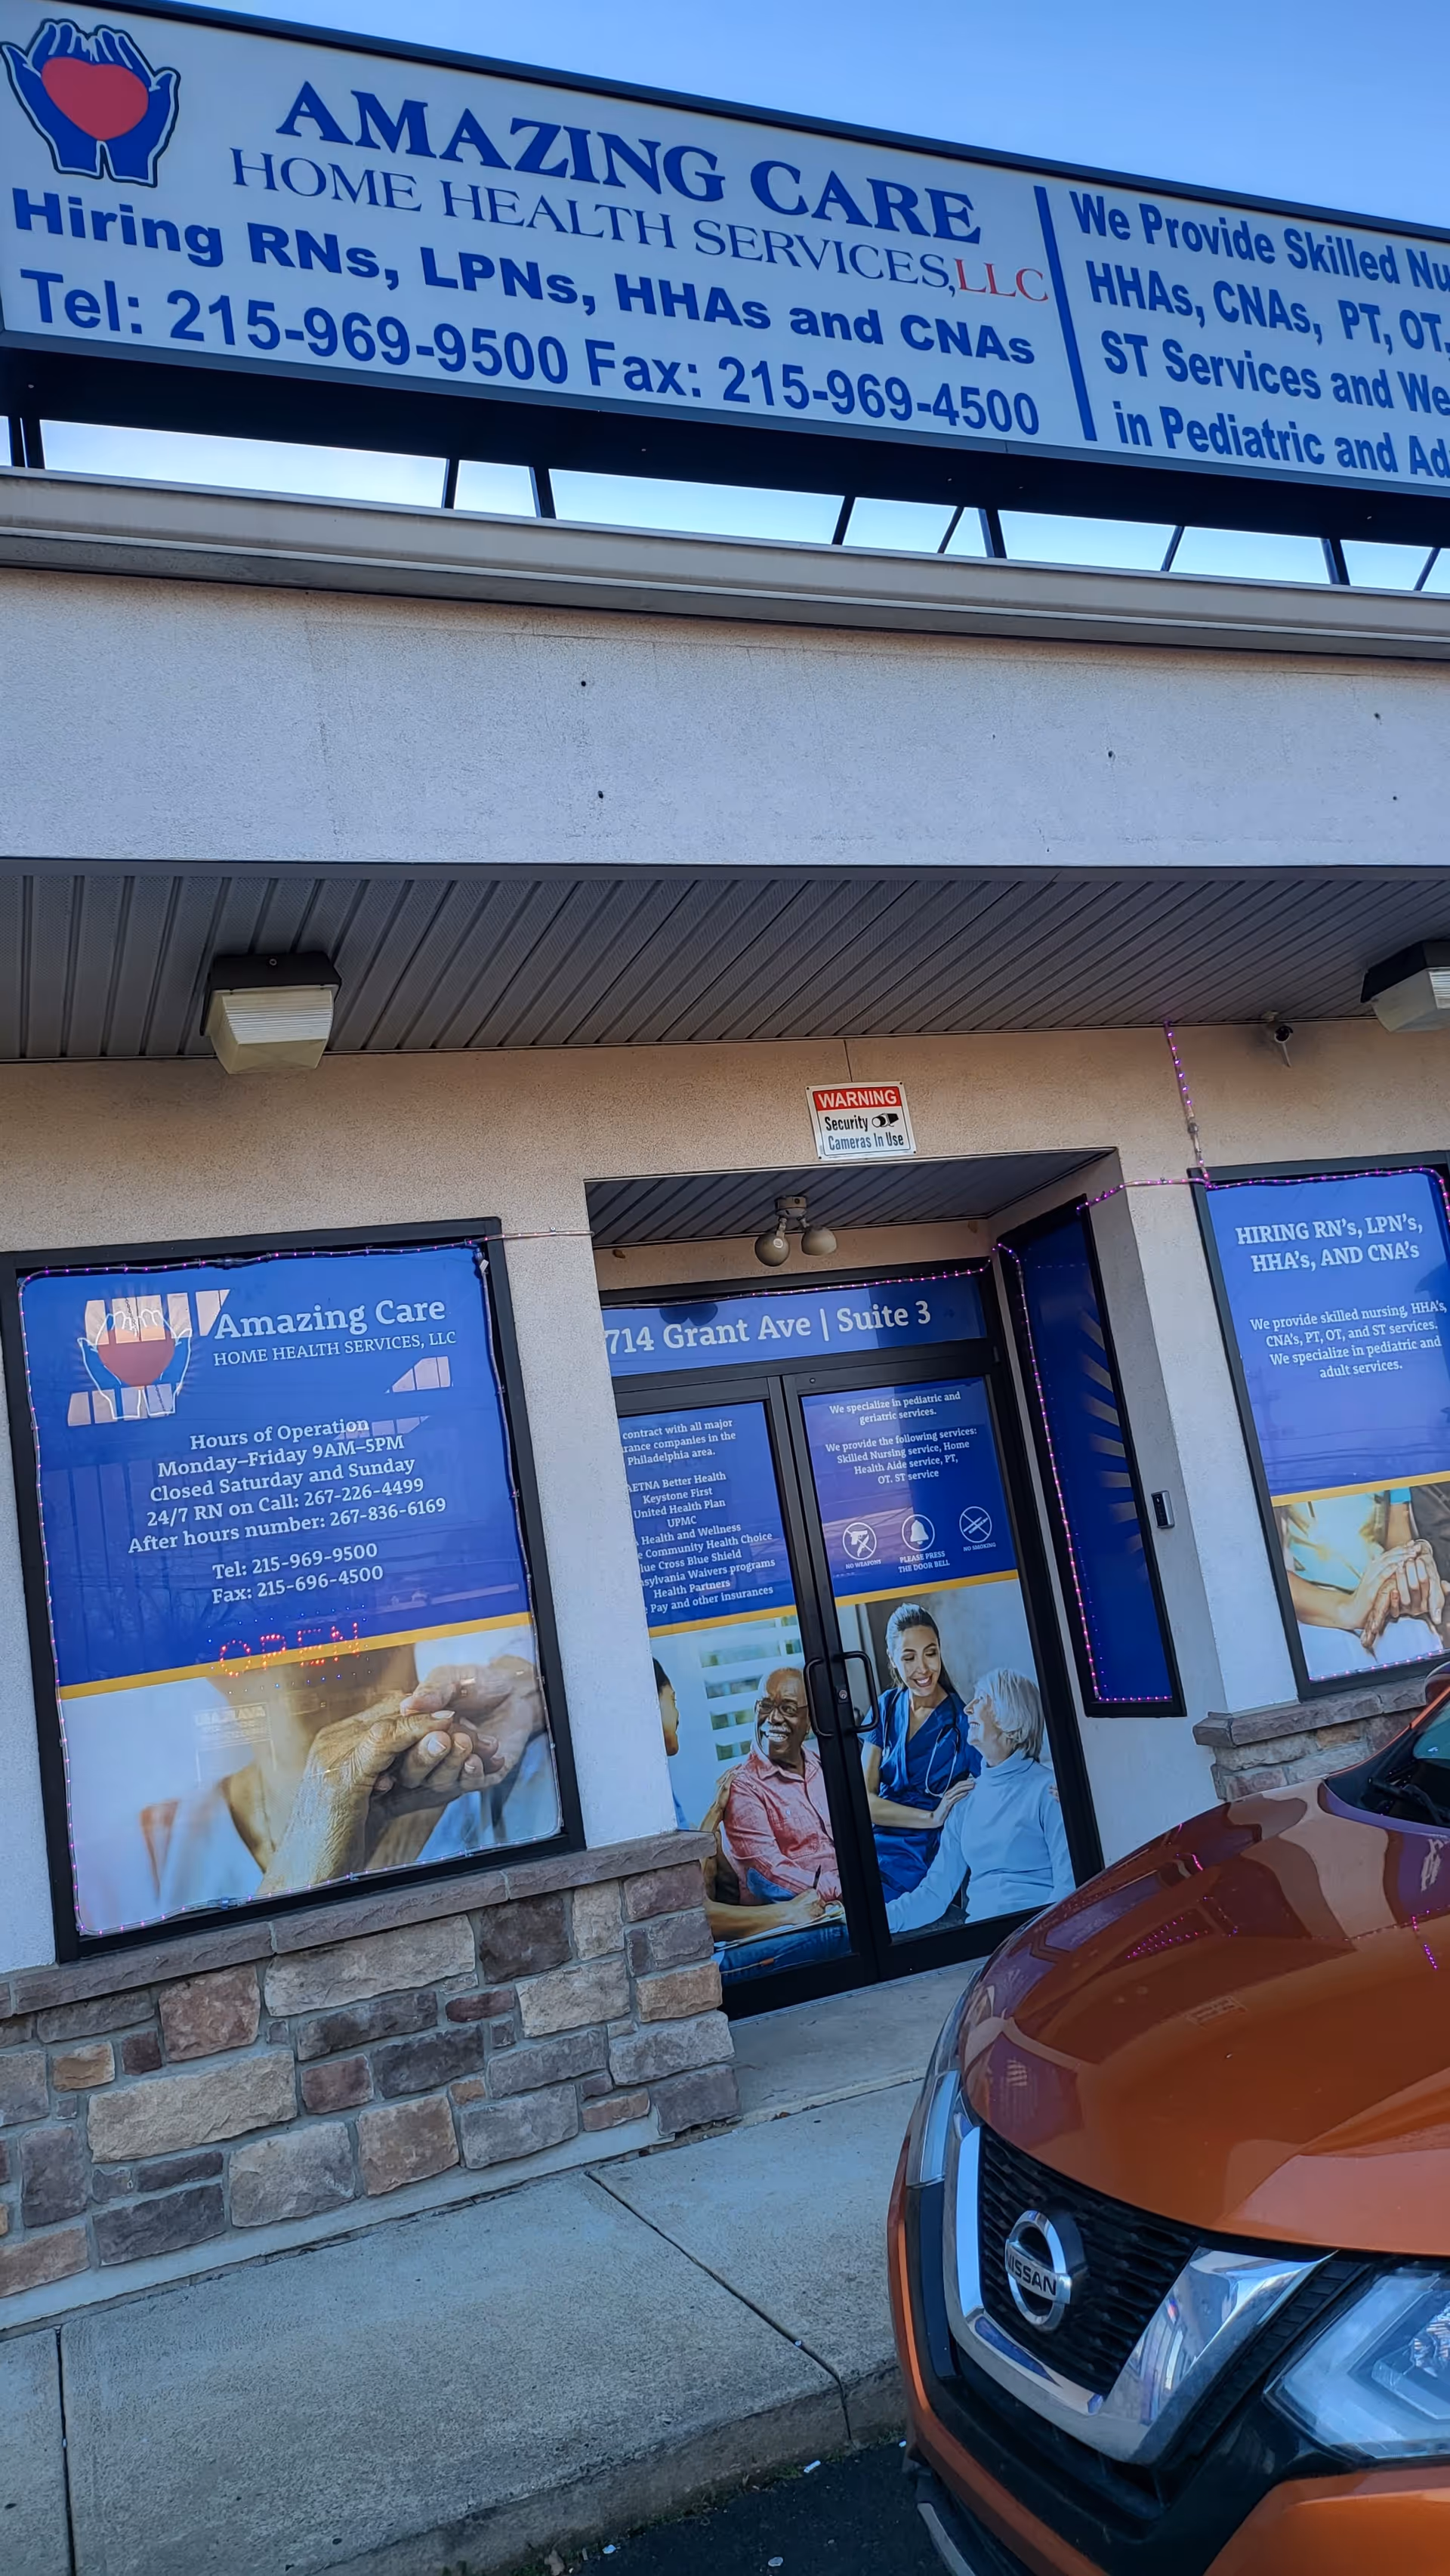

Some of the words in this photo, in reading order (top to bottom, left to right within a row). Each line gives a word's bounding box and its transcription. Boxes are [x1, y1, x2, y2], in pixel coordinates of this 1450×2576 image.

[276, 81, 726, 202] AMAZING
[751, 161, 980, 244] CARE
[230, 148, 421, 212] HOME
[440, 181, 677, 249] HEALTH
[1069, 191, 1131, 239] We
[1139, 203, 1275, 264] Provide
[1284, 228, 1400, 284] Skilled
[12, 188, 223, 267] Hiring
[248, 223, 399, 290] RNs,
[421, 247, 595, 316] LPNs,
[615, 273, 770, 329] HHAs
[790, 308, 884, 344] and
[900, 315, 1034, 363] CNAs
[1086, 261, 1205, 328] HHAs,
[1214, 281, 1322, 344] CNAs,
[1338, 300, 1393, 355] PT,
[20, 269, 142, 334] Tel:
[167, 290, 568, 384] 215-969-9500
[585, 339, 701, 397] Fax:
[719, 357, 1038, 435] 215-969-4500
[1101, 330, 1148, 377] ST
[1162, 339, 1321, 399] Services
[1331, 369, 1394, 408] and
[1113, 401, 1152, 446] in
[1159, 406, 1325, 465] Pediatric
[1334, 432, 1398, 472] and
[818, 1090, 896, 1108] WARNING
[825, 1115, 868, 1132] Security
[828, 1135, 872, 1151] Cameras
[874, 1133, 884, 1147] In
[885, 1132, 904, 1146] Use
[1236, 1223, 1309, 1244] HIRING
[1313, 1219, 1362, 1238] RN's,
[1365, 1214, 1422, 1234] LPN's,
[1251, 1251, 1316, 1271] HHA's,
[1321, 1247, 1362, 1265] AND
[1368, 1241, 1419, 1261] CNA's
[214, 1305, 367, 1339] Amazing
[376, 1300, 445, 1324] Care
[605, 1326, 654, 1354] 714
[664, 1318, 750, 1348] Grant
[758, 1316, 810, 1339] Ave
[838, 1304, 909, 1331] Suite
[916, 1301, 930, 1324] 3
[1250, 1319, 1270, 1330] We
[1273, 1314, 1318, 1332] provide
[1321, 1308, 1359, 1323] skilled
[1361, 1305, 1408, 1319] nursing,
[1411, 1300, 1447, 1314] HHA's,
[1266, 1333, 1303, 1347] CNA's,
[1304, 1331, 1323, 1344] PT,
[1325, 1329, 1346, 1342] OT,
[1348, 1326, 1370, 1338] and
[1372, 1324, 1385, 1336] ST
[1390, 1320, 1437, 1334] services.
[214, 1349, 267, 1366] HOME
[273, 1342, 340, 1360] HEALTH
[345, 1335, 424, 1353] SERVICES,
[429, 1332, 456, 1345] LLC
[1270, 1354, 1289, 1365] We
[1292, 1347, 1350, 1365] specialize
[1366, 1339, 1418, 1357] pediatric
[1420, 1336, 1442, 1348] and
[1320, 1364, 1350, 1378] adult
[1353, 1361, 1402, 1374] services.
[829, 1405, 844, 1413] We
[847, 1401, 890, 1413] specialize
[903, 1394, 942, 1407] pediatric
[944, 1391, 961, 1401] and
[623, 1428, 662, 1439] contract
[665, 1424, 687, 1434] with
[704, 1419, 732, 1430] major
[860, 1411, 896, 1425] geriatric
[899, 1408, 936, 1419] services.
[190, 1434, 248, 1450] Hours
[254, 1426, 273, 1442] of
[278, 1419, 369, 1442] Operation
[654, 1436, 705, 1449] companies
[842, 1438, 876, 1453] provide
[879, 1437, 893, 1445] the
[896, 1432, 937, 1444] following
[939, 1428, 976, 1438] services:
[628, 1450, 690, 1466] Philadelphia
[692, 1449, 715, 1457] area.
[838, 1452, 868, 1463] Skilled
[870, 1449, 906, 1459] Nursing
[908, 1444, 941, 1455] service,
[943, 1441, 969, 1450] Home
[854, 1463, 884, 1474] Health
[887, 1460, 906, 1470] Aide
[909, 1457, 942, 1467] service,
[944, 1454, 958, 1463] PT,
[150, 1480, 214, 1501] Closed
[220, 1472, 303, 1493] Saturday
[310, 1465, 344, 1482] and
[349, 1459, 415, 1477] Sunday
[662, 1478, 691, 1487] Better
[694, 1472, 726, 1484] Health
[908, 1470, 939, 1481] service
[147, 1508, 187, 1527] 24/7
[194, 1503, 223, 1520] RN
[230, 1503, 254, 1515] on
[259, 1493, 298, 1512] Call:
[304, 1478, 423, 1510] 267-226-4499
[634, 1506, 667, 1518] United
[669, 1502, 702, 1514] Health
[704, 1500, 726, 1509] Plan
[643, 1492, 688, 1504] Keystone
[690, 1487, 712, 1497] First
[128, 1536, 177, 1553] After
[183, 1528, 239, 1546] hours
[245, 1517, 325, 1537] number:
[330, 1493, 446, 1526] 267-836-6169
[641, 1533, 674, 1545] Health
[677, 1529, 696, 1540] and
[698, 1524, 741, 1536] Wellness
[667, 1515, 696, 1527] UPMC
[646, 1543, 703, 1558] Community
[706, 1537, 739, 1549] Health
[741, 1531, 773, 1544] Choice
[899, 1554, 924, 1563] PLEASE
[925, 1551, 945, 1559] PRESS
[212, 1561, 246, 1579] Tel:
[252, 1543, 377, 1574] 215-969-9500
[659, 1560, 684, 1569] Cross
[687, 1555, 708, 1565] Blue
[711, 1549, 742, 1561] Shield
[687, 1567, 727, 1579] Waivers
[730, 1560, 775, 1575] programs
[855, 1559, 881, 1568] WEAPONS
[898, 1564, 912, 1573] THE
[913, 1562, 933, 1571] DOOR
[212, 1589, 251, 1603] Fax:
[257, 1565, 384, 1598] 215-696-4500
[653, 1585, 686, 1598] Health
[690, 1580, 730, 1592] Partners
[650, 1604, 668, 1614] Pay
[671, 1598, 690, 1609] and
[693, 1593, 718, 1606] other
[721, 1587, 773, 1601] insurances
[219, 1622, 359, 1677] OPEN
[1007, 2253, 1056, 2295] NISSAN
